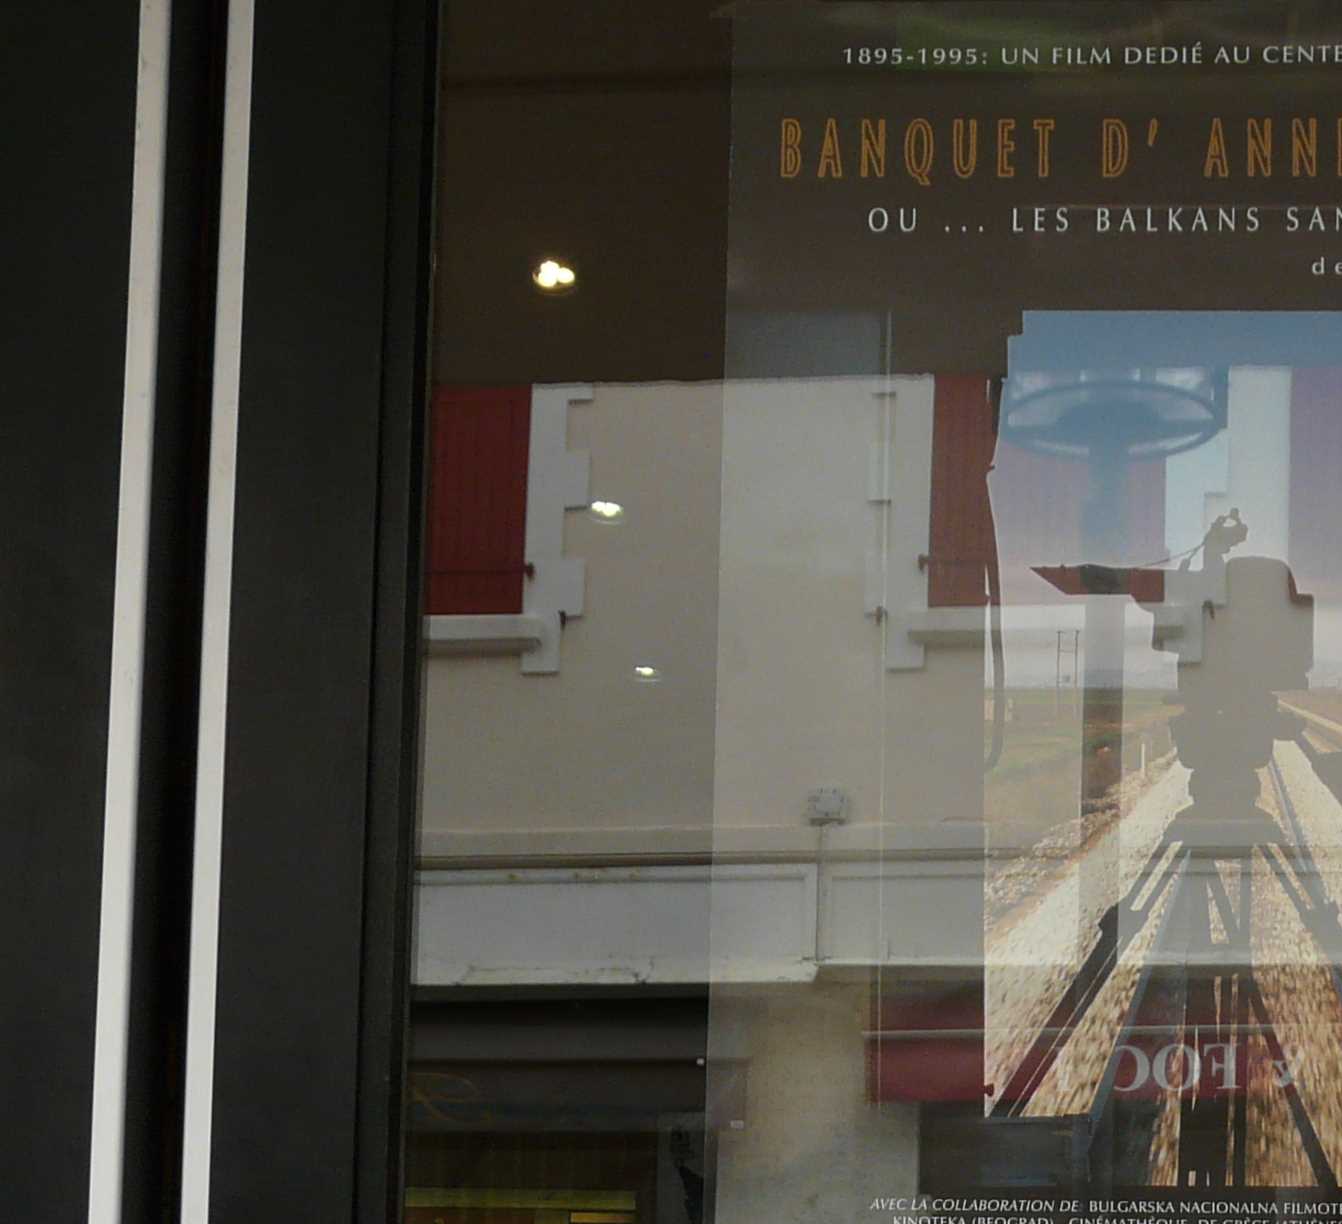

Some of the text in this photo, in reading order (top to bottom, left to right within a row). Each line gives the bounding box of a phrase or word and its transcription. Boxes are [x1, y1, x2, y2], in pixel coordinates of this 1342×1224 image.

[843, 47, 988, 65] 1895-1995:
[1001, 48, 1039, 65] UN
[1052, 47, 1111, 65] FILM
[1124, 42, 1203, 64] DEDIÉ
[1214, 45, 1250, 64] AU
[780, 117, 1056, 187] BANQUET
[867, 207, 918, 233] OU
[1011, 207, 1070, 233] LES
[1095, 206, 1260, 232] BALKANS
[870, 1198, 910, 1211] AVEC
[911, 1199, 928, 1211] LA
[932, 1199, 1054, 1212] COLLABORATION
[1089, 1200, 1175, 1214] BULGARSKA
[1180, 1201, 1278, 1215] NACIONALNA
